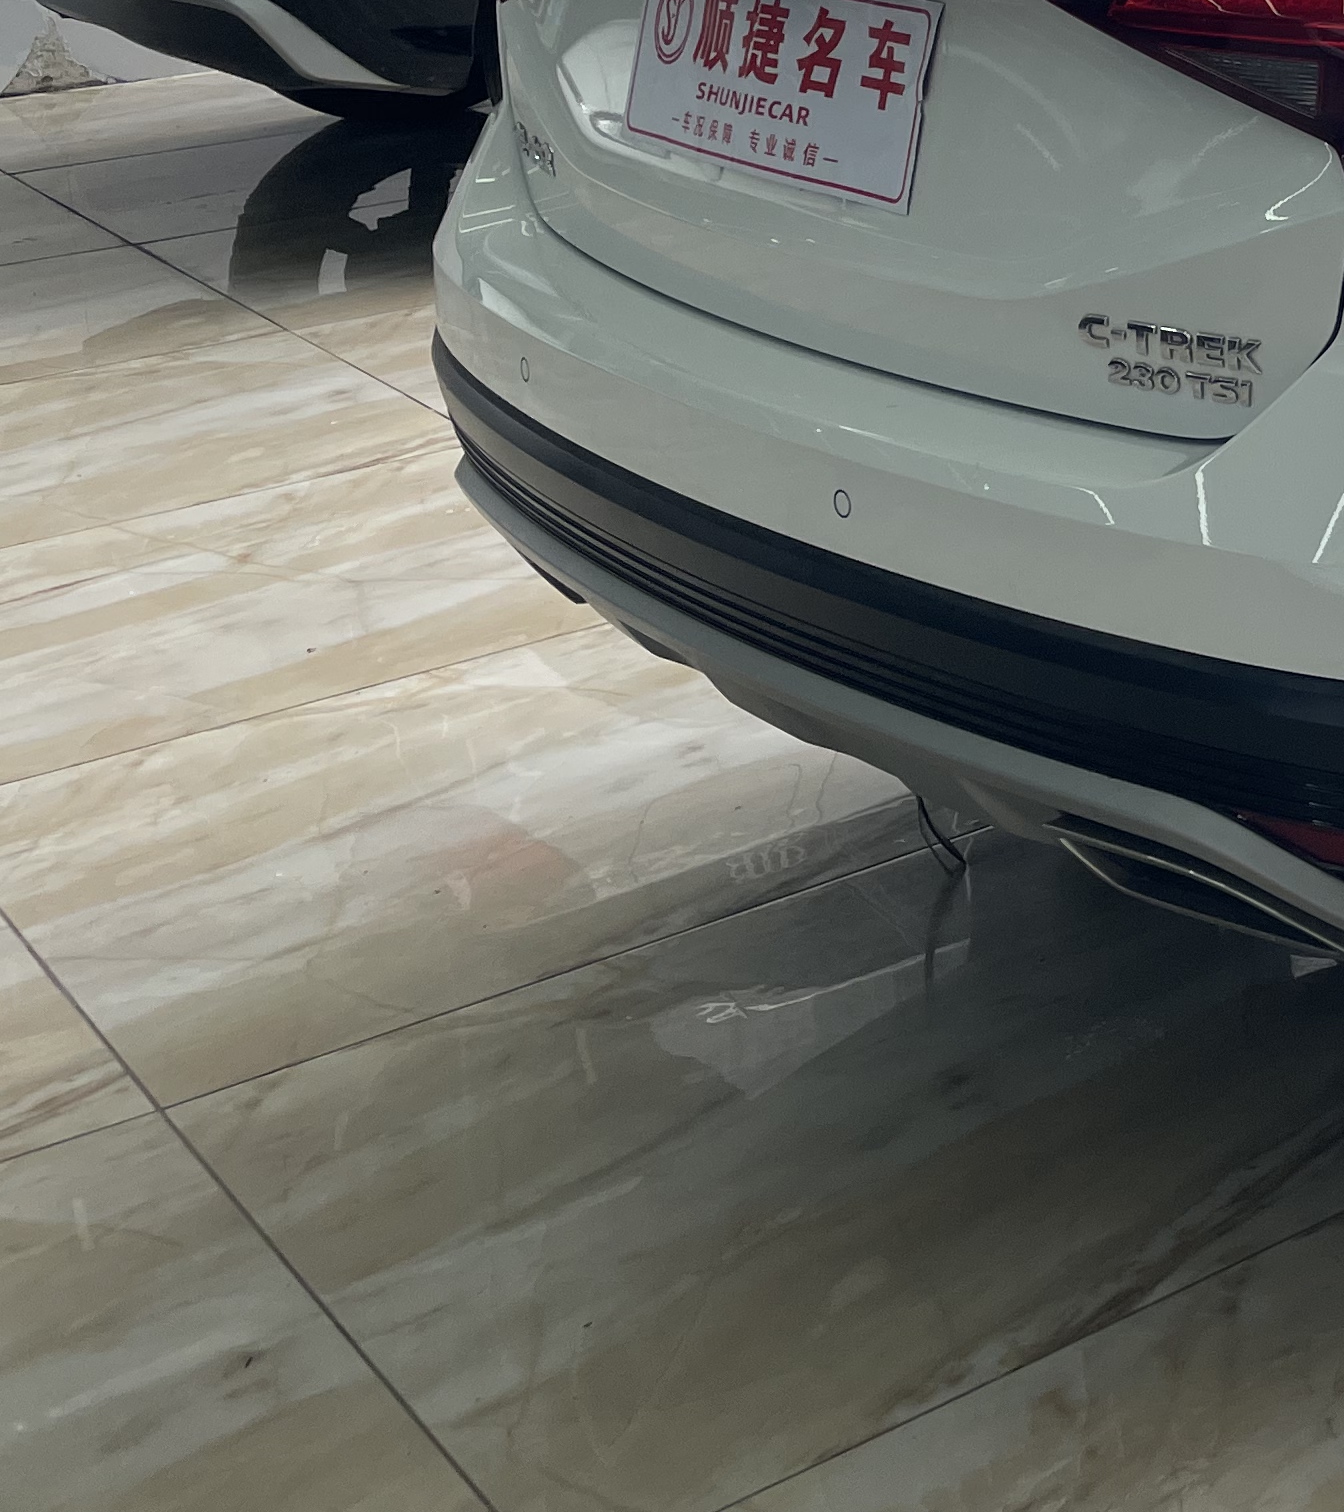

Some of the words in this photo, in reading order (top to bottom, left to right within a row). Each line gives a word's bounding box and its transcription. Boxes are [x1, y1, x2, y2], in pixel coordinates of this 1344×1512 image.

[695, 81, 810, 127] SHUNJIECAR
[1078, 312, 1263, 375] C-TREK
[1108, 356, 1182, 395] 230
[1185, 369, 1254, 408] TSI
